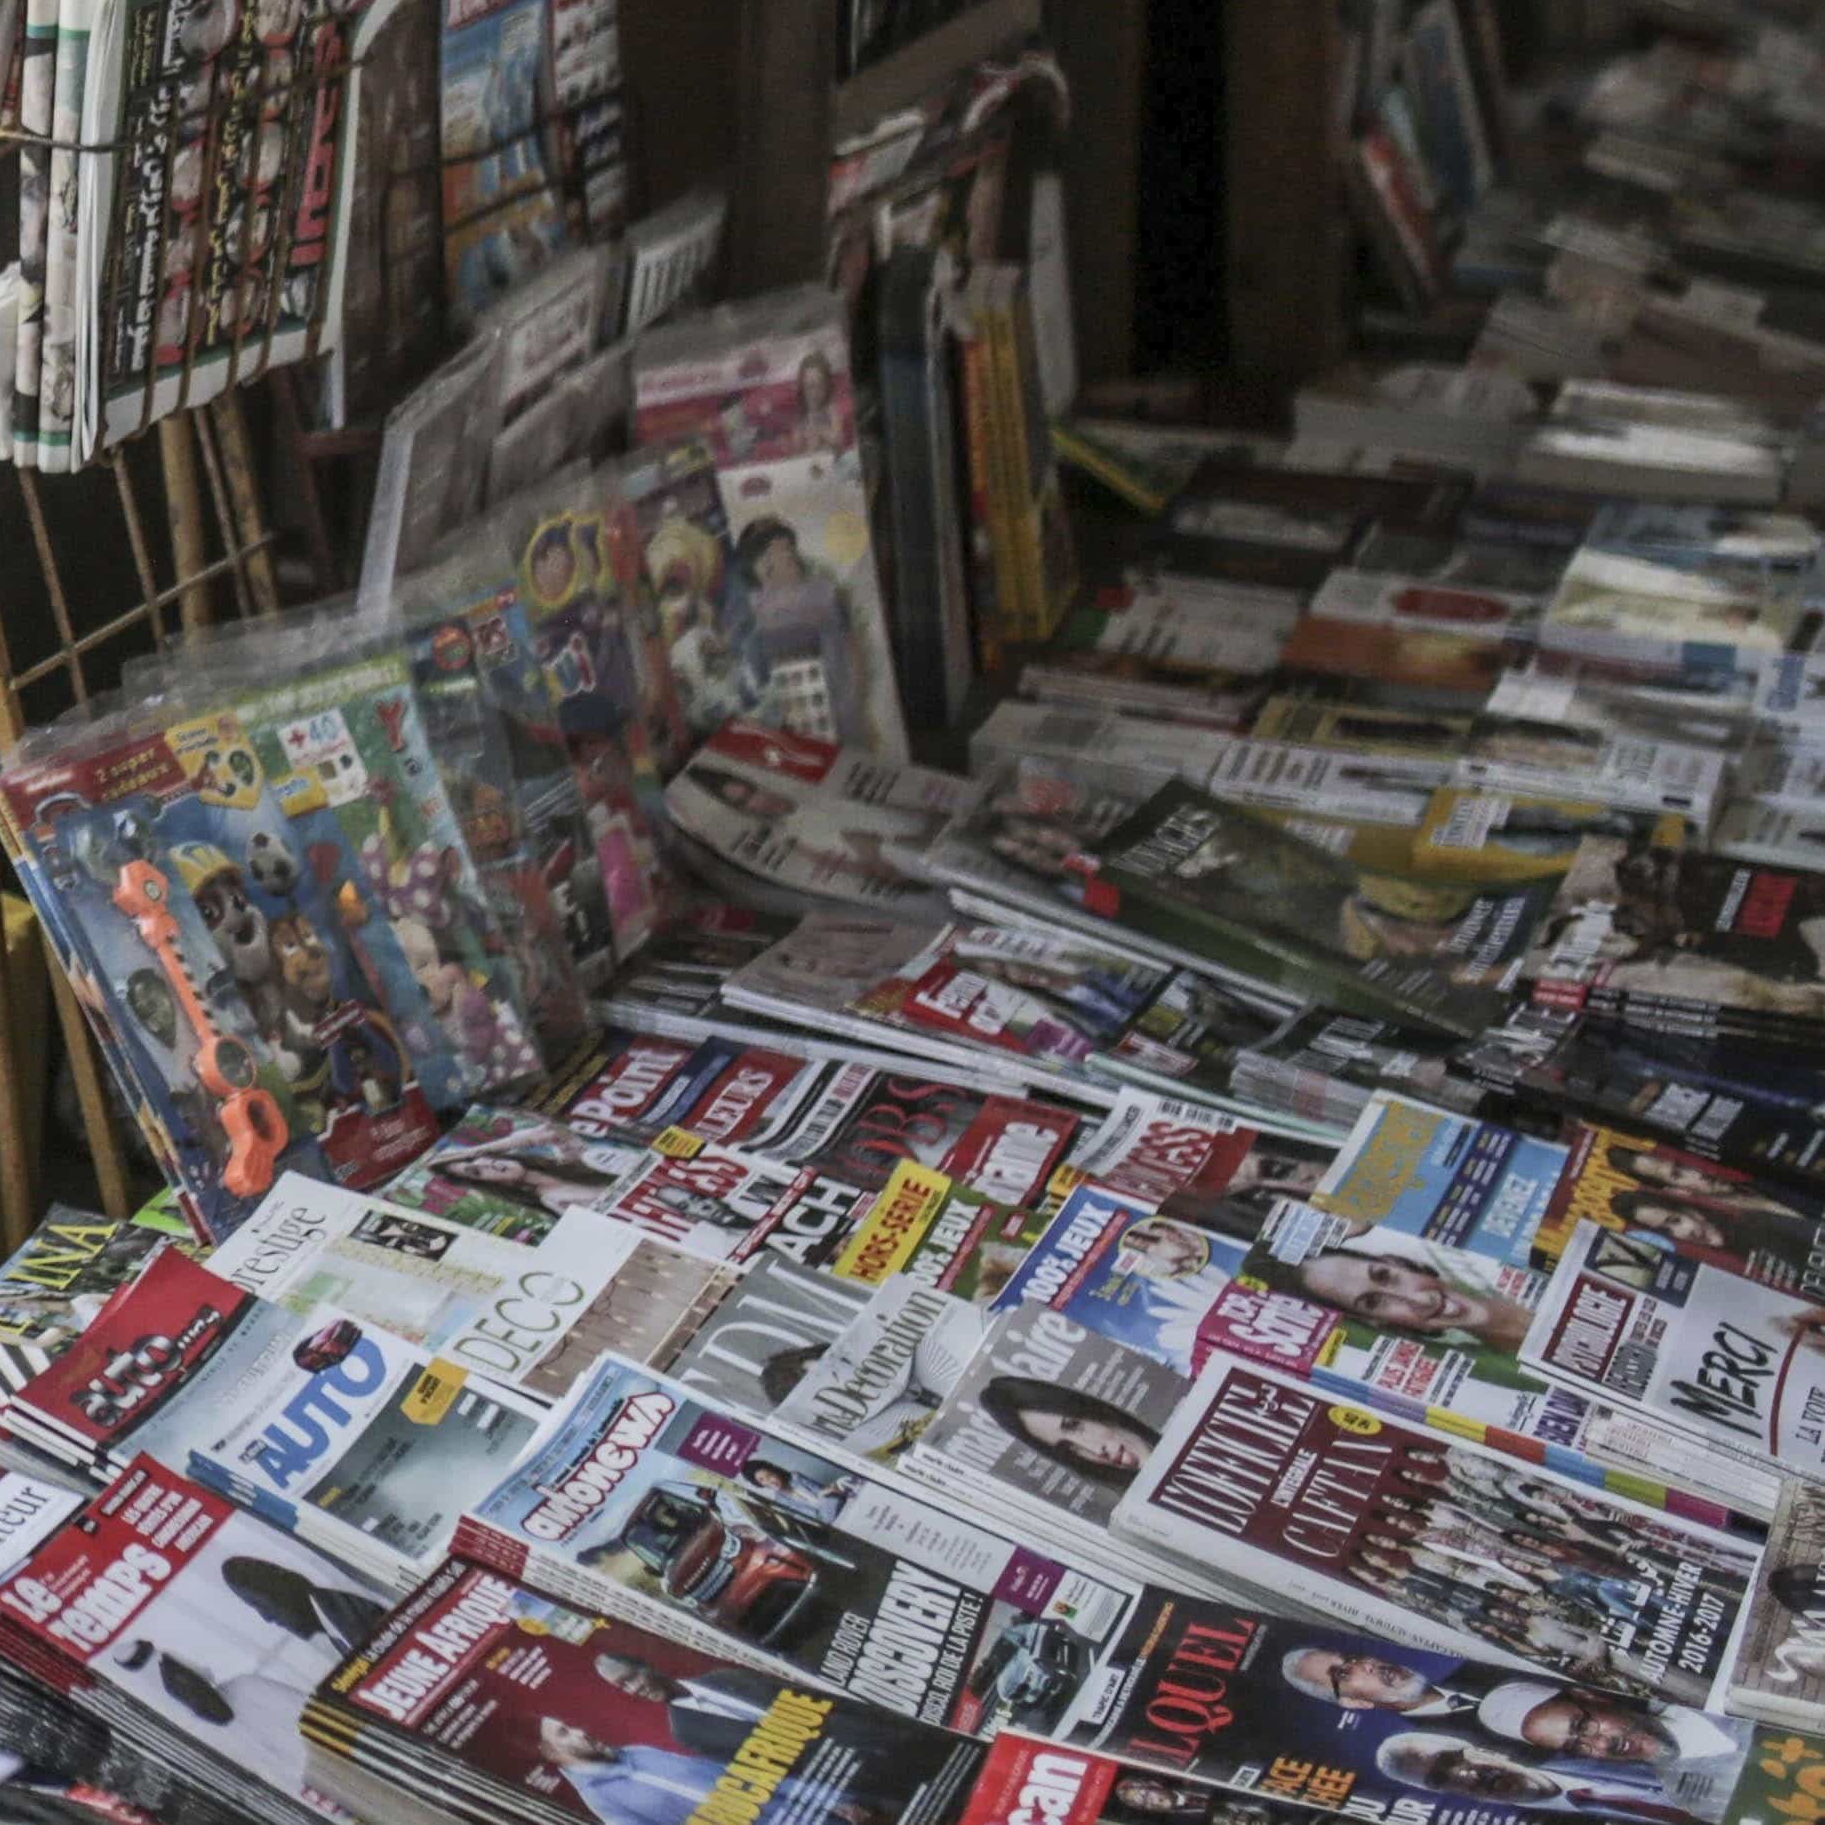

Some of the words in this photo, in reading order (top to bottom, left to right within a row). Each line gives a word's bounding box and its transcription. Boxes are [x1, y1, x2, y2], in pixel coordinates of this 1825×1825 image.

[574, 1044, 681, 1121] Point
[852, 1178, 932, 1282] HORS-SÉRIE
[929, 1197, 981, 1254] JEUX
[1025, 1250, 1076, 1302] 100%
[1054, 1202, 1111, 1262] JEUX
[453, 1271, 583, 1374] DECO
[72, 1331, 180, 1425] auto
[254, 1336, 389, 1489] AUTO
[1668, 1318, 1777, 1438] MERCI
[1159, 1366, 1315, 1533] L'OFFICIEL
[1269, 1445, 1317, 1509] L'INTÉGRALE
[1282, 1428, 1393, 1559] CAFTAN
[358, 1646, 448, 1720] JEUNE
[415, 1575, 516, 1663] AFRIQUE
[831, 1611, 869, 1656] ROVER
[848, 1561, 961, 1715] DISCOVERY
[939, 1648, 961, 1671] DE
[947, 1632, 967, 1652] LA
[953, 1598, 981, 1637] PISTE
[1639, 1562, 1703, 1684] AUTOMNE-HIVER
[1679, 1592, 1726, 1672] 2016-2017
[818, 1648, 853, 1686] LAND
[931, 1664, 956, 1690] ROI
